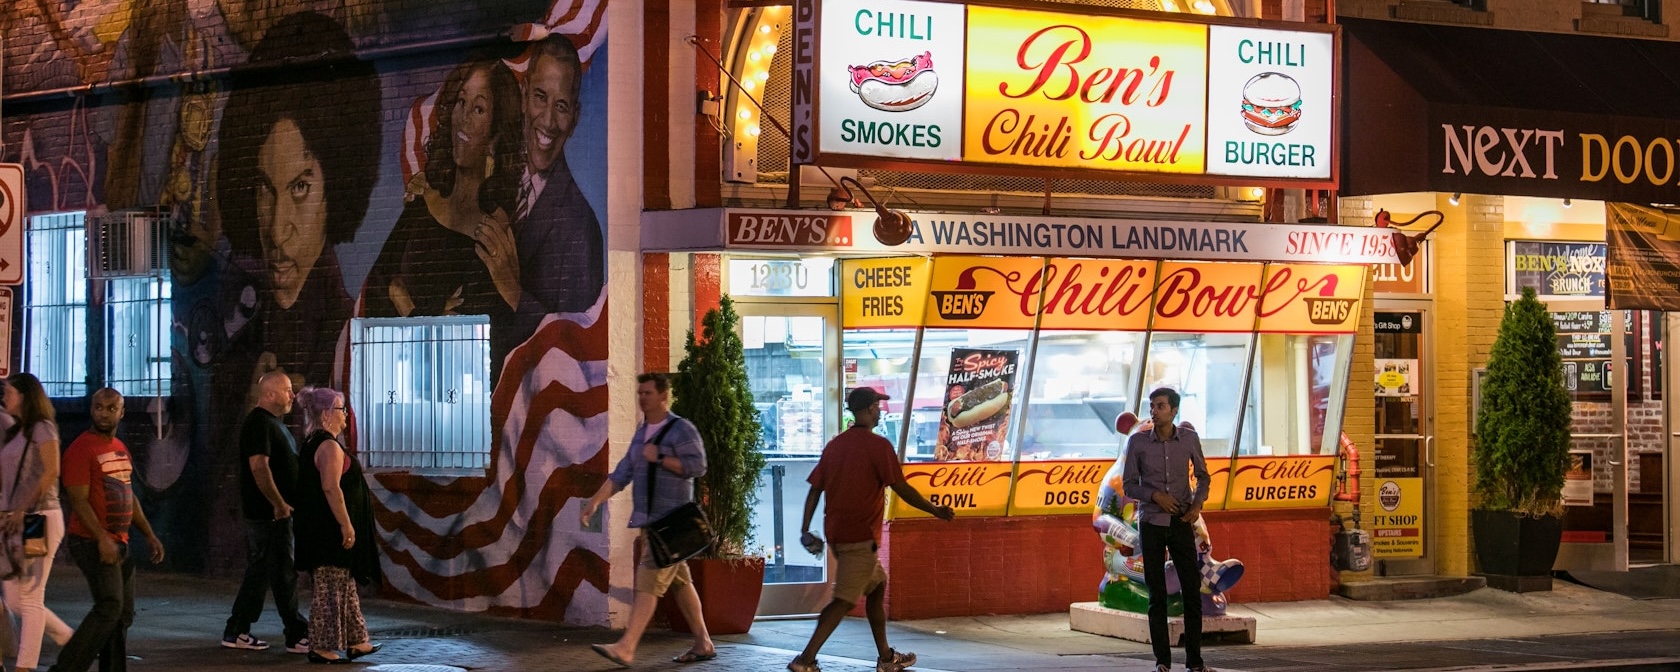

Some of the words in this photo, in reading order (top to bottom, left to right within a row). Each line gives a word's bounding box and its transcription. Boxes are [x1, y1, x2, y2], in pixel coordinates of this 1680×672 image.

[855, 9, 933, 41] CHILI
[1238, 39, 1306, 67] CHILI
[999, 25, 1174, 108] Ben's
[840, 119, 942, 148] SMOKES
[982, 108, 1071, 159] Chili
[1078, 113, 1192, 165] Bowl
[1225, 140, 1316, 167] BURGER
[1579, 132, 1680, 187] DOO
[906, 219, 924, 244] A
[930, 220, 1104, 249] WASHINGTON
[1112, 225, 1249, 253] LANDMARK
[1285, 231, 1354, 256] SINCE
[1360, 233, 1397, 258] 1958
[1515, 254, 1567, 272] BEN'S
[854, 266, 912, 289] CHEESE
[1552, 277, 1591, 292] BRUNCH
[1019, 262, 1148, 317] Chili
[1156, 266, 1292, 318] Bowl
[862, 295, 904, 317] FRIES
[941, 293, 984, 315] BEN'S
[1311, 300, 1350, 321] BEN'S
[1378, 322, 1387, 330] Gift
[1388, 322, 1401, 331] Shop
[948, 363, 1016, 385] HALF-SMOKE
[964, 353, 1008, 374] Spicy
[929, 466, 989, 488] Chili
[1045, 464, 1102, 485] Chili
[1260, 460, 1313, 480] Chili
[930, 493, 977, 508] BOWL
[1044, 490, 1090, 506] DOGS
[1245, 485, 1317, 501] BURGERS
[1380, 486, 1397, 495] Ben's
[1389, 515, 1418, 525] SHOP
[1378, 529, 1402, 537] UPSTAIRS
